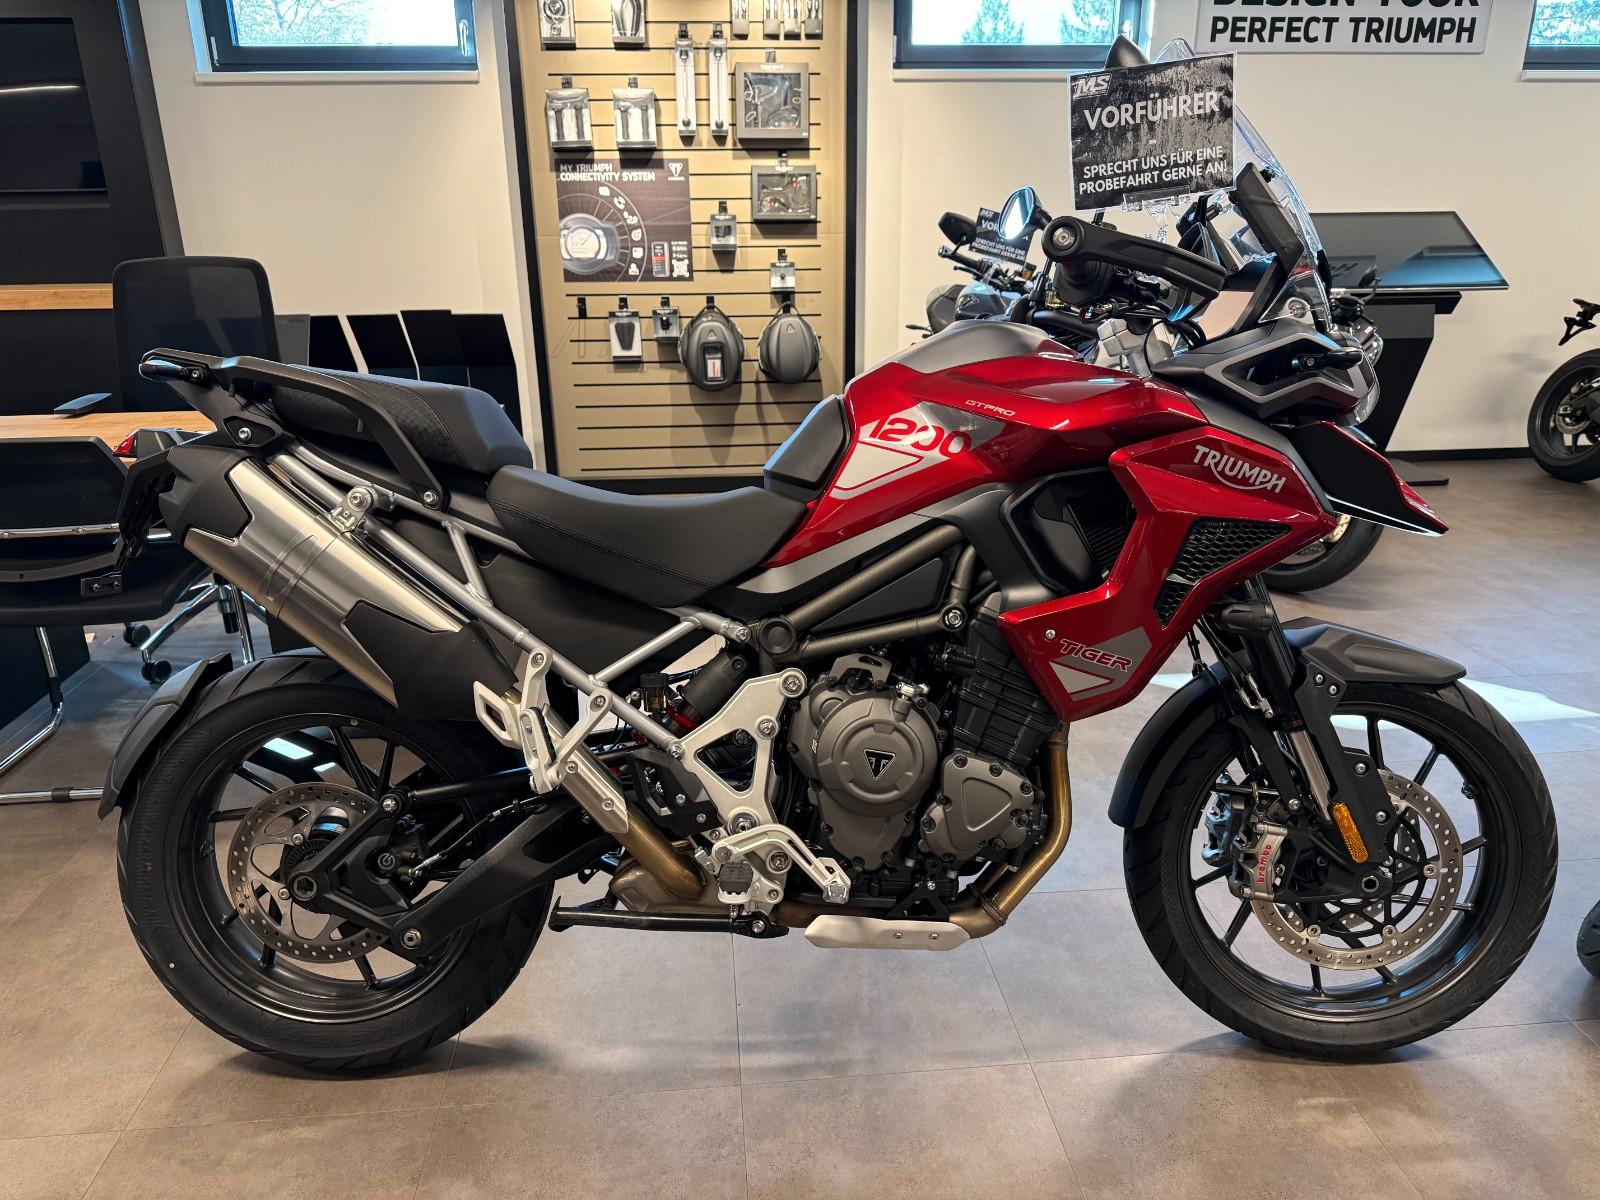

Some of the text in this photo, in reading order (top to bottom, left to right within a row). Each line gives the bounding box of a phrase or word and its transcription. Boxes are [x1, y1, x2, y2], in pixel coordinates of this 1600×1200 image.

[1210, 15, 1478, 44] PERFECT TRIUMPH
[1084, 91, 1220, 131] VORFÜHRER
[560, 163, 613, 172] MY TRIUMPH
[560, 172, 620, 182] CONNECTIVITY
[622, 172, 656, 182] SYSTEM
[1079, 159, 1227, 195] PROBEFAHRT GERNE AN!
[1083, 145, 1223, 179] SPRECHT UNS FÜR EINE
[869, 417, 972, 456] 1200
[1193, 444, 1287, 494] TRIUMPH
[1059, 638, 1133, 673] TIGER
[1256, 844, 1272, 884] brembo
